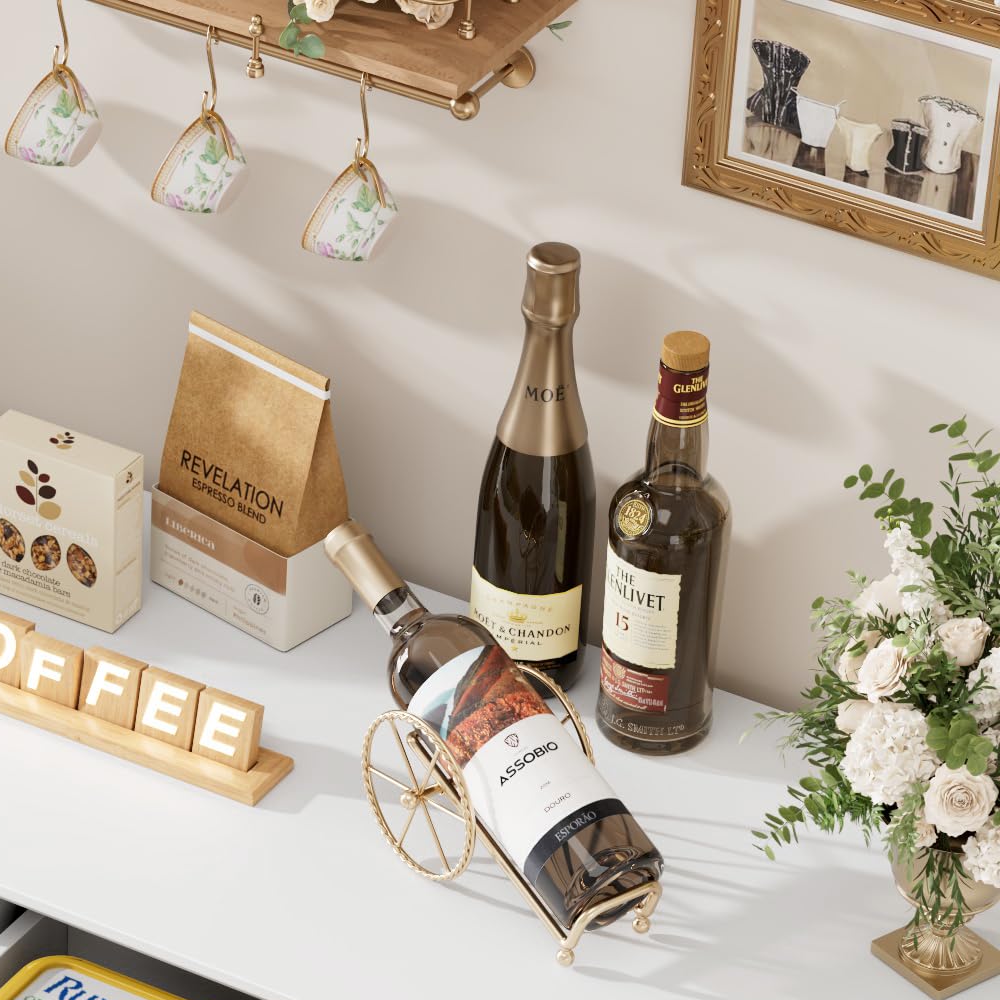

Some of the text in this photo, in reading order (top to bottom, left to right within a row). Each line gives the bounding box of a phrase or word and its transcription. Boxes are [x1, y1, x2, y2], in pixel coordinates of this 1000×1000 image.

[180, 449, 284, 518] REVELATION
[192, 477, 267, 525] ESPRESSO BLEND
[623, 505, 647, 525] 1824
[2, 560, 21, 573] dark
[22, 567, 61, 588] chocolate
[3, 568, 52, 591] macadamia
[53, 585, 71, 599] bars
[616, 565, 636, 587] THE
[499, 626, 507, 634] &
[508, 623, 572, 640] CHANDON
[615, 611, 630, 632] 15
[627, 722, 664, 736] SMITH
[499, 741, 559, 787] ASSOBIO
[543, 791, 571, 814] DOURO
[554, 810, 597, 843] ESPORÃO
